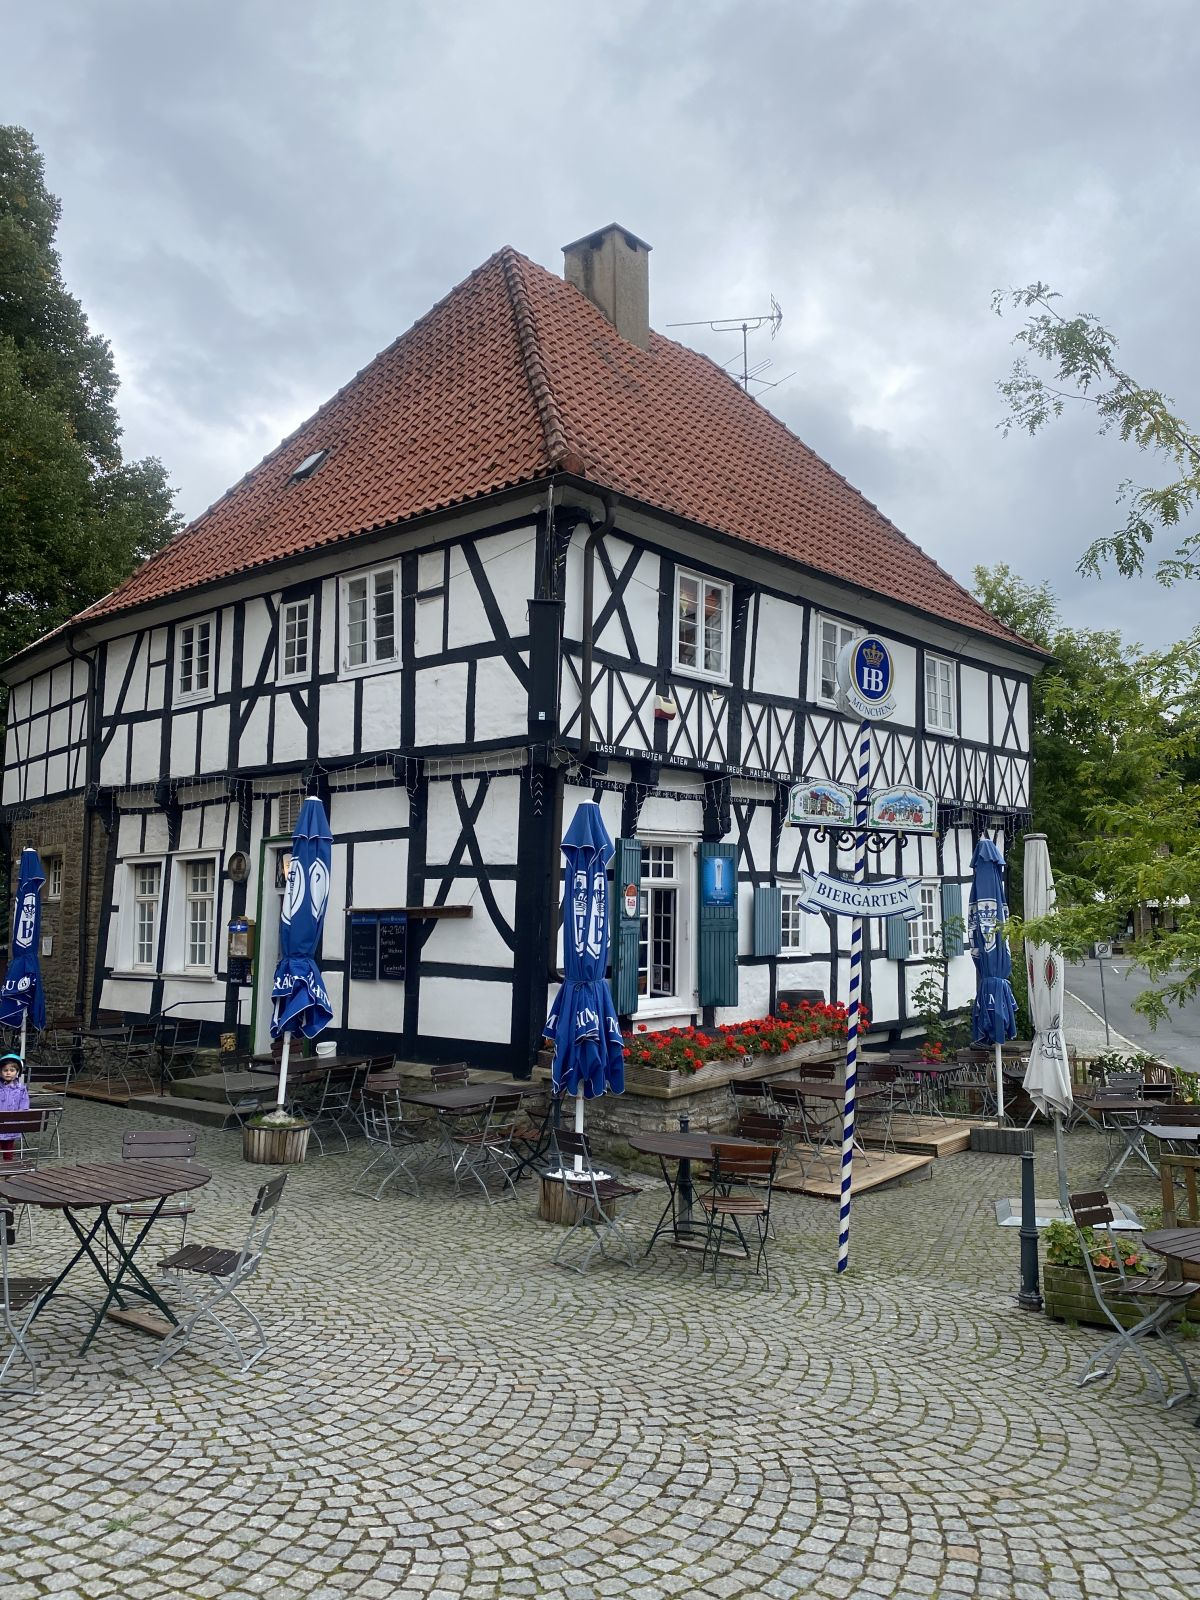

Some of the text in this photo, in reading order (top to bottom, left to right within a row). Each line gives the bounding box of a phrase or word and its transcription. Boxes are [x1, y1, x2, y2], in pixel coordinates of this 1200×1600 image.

[862, 666, 883, 692] HB
[595, 743, 617, 754] LASST
[641, 750, 663, 762] GUTEN
[669, 756, 688, 766] ALTEN
[697, 760, 709, 769] UNS
[714, 763, 720, 771] IN
[749, 768, 771, 779] HALTEN
[777, 772, 791, 781] ABER
[817, 882, 909, 908] BIERGARTEN
